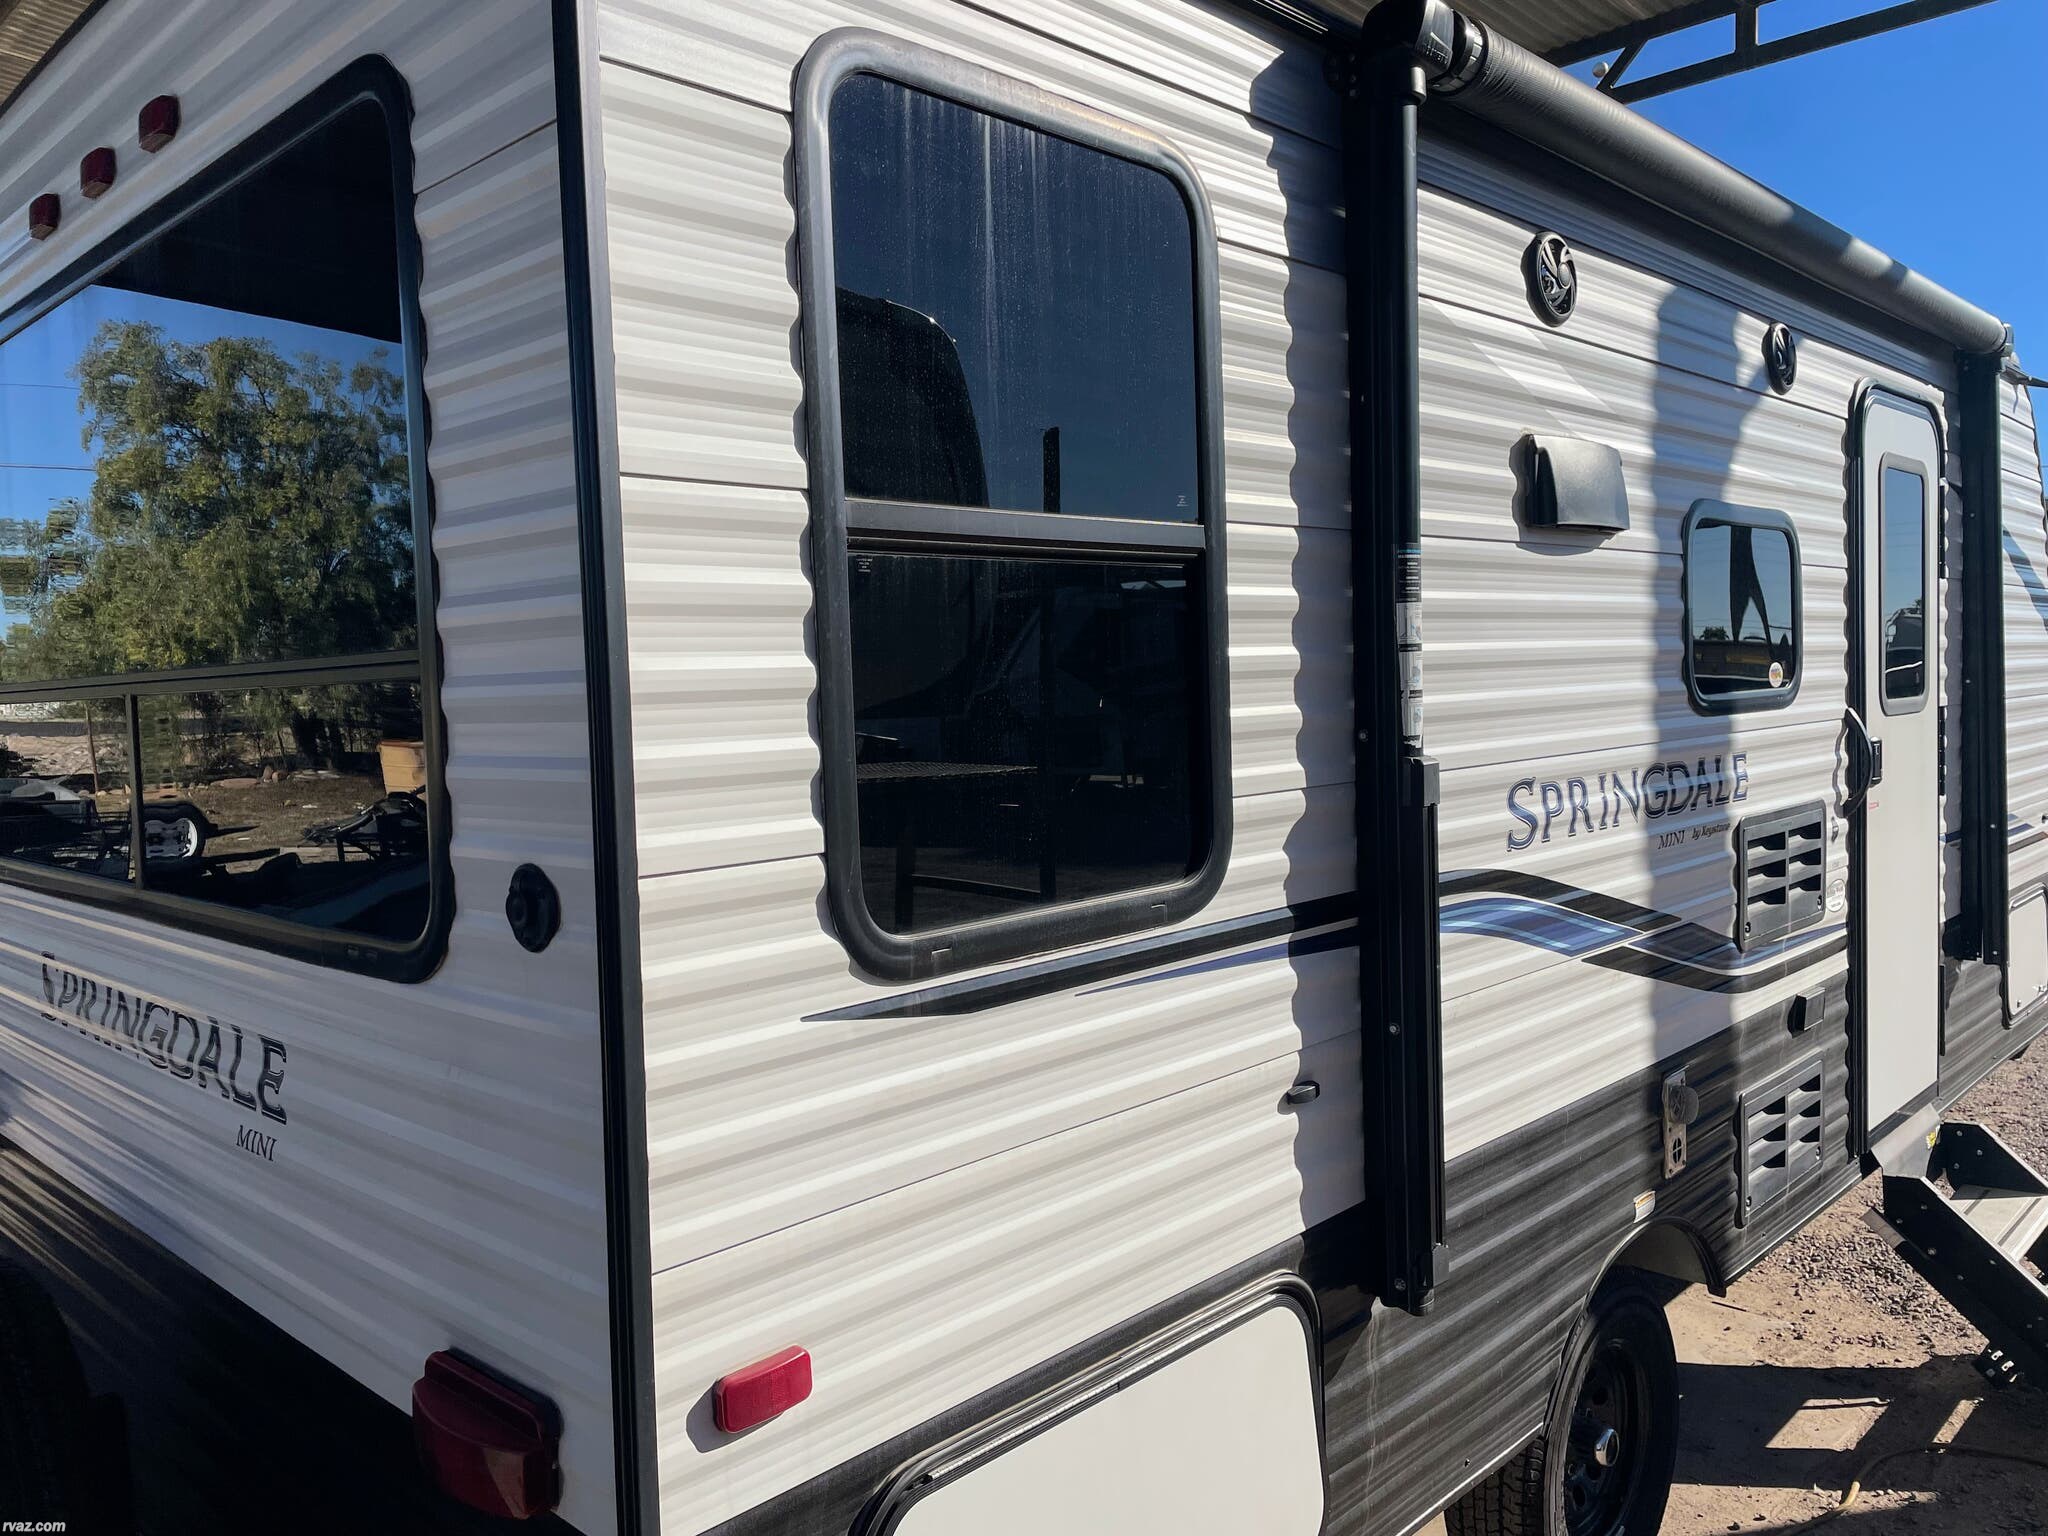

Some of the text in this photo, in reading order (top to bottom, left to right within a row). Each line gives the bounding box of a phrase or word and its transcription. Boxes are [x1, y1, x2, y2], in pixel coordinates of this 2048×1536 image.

[1506, 751, 1749, 852] SPRINGDALE
[1657, 829, 1686, 850] MINI
[1691, 827, 1701, 841] by
[40, 951, 288, 1125] SPRINGDALE
[235, 1125, 278, 1161] MINI
